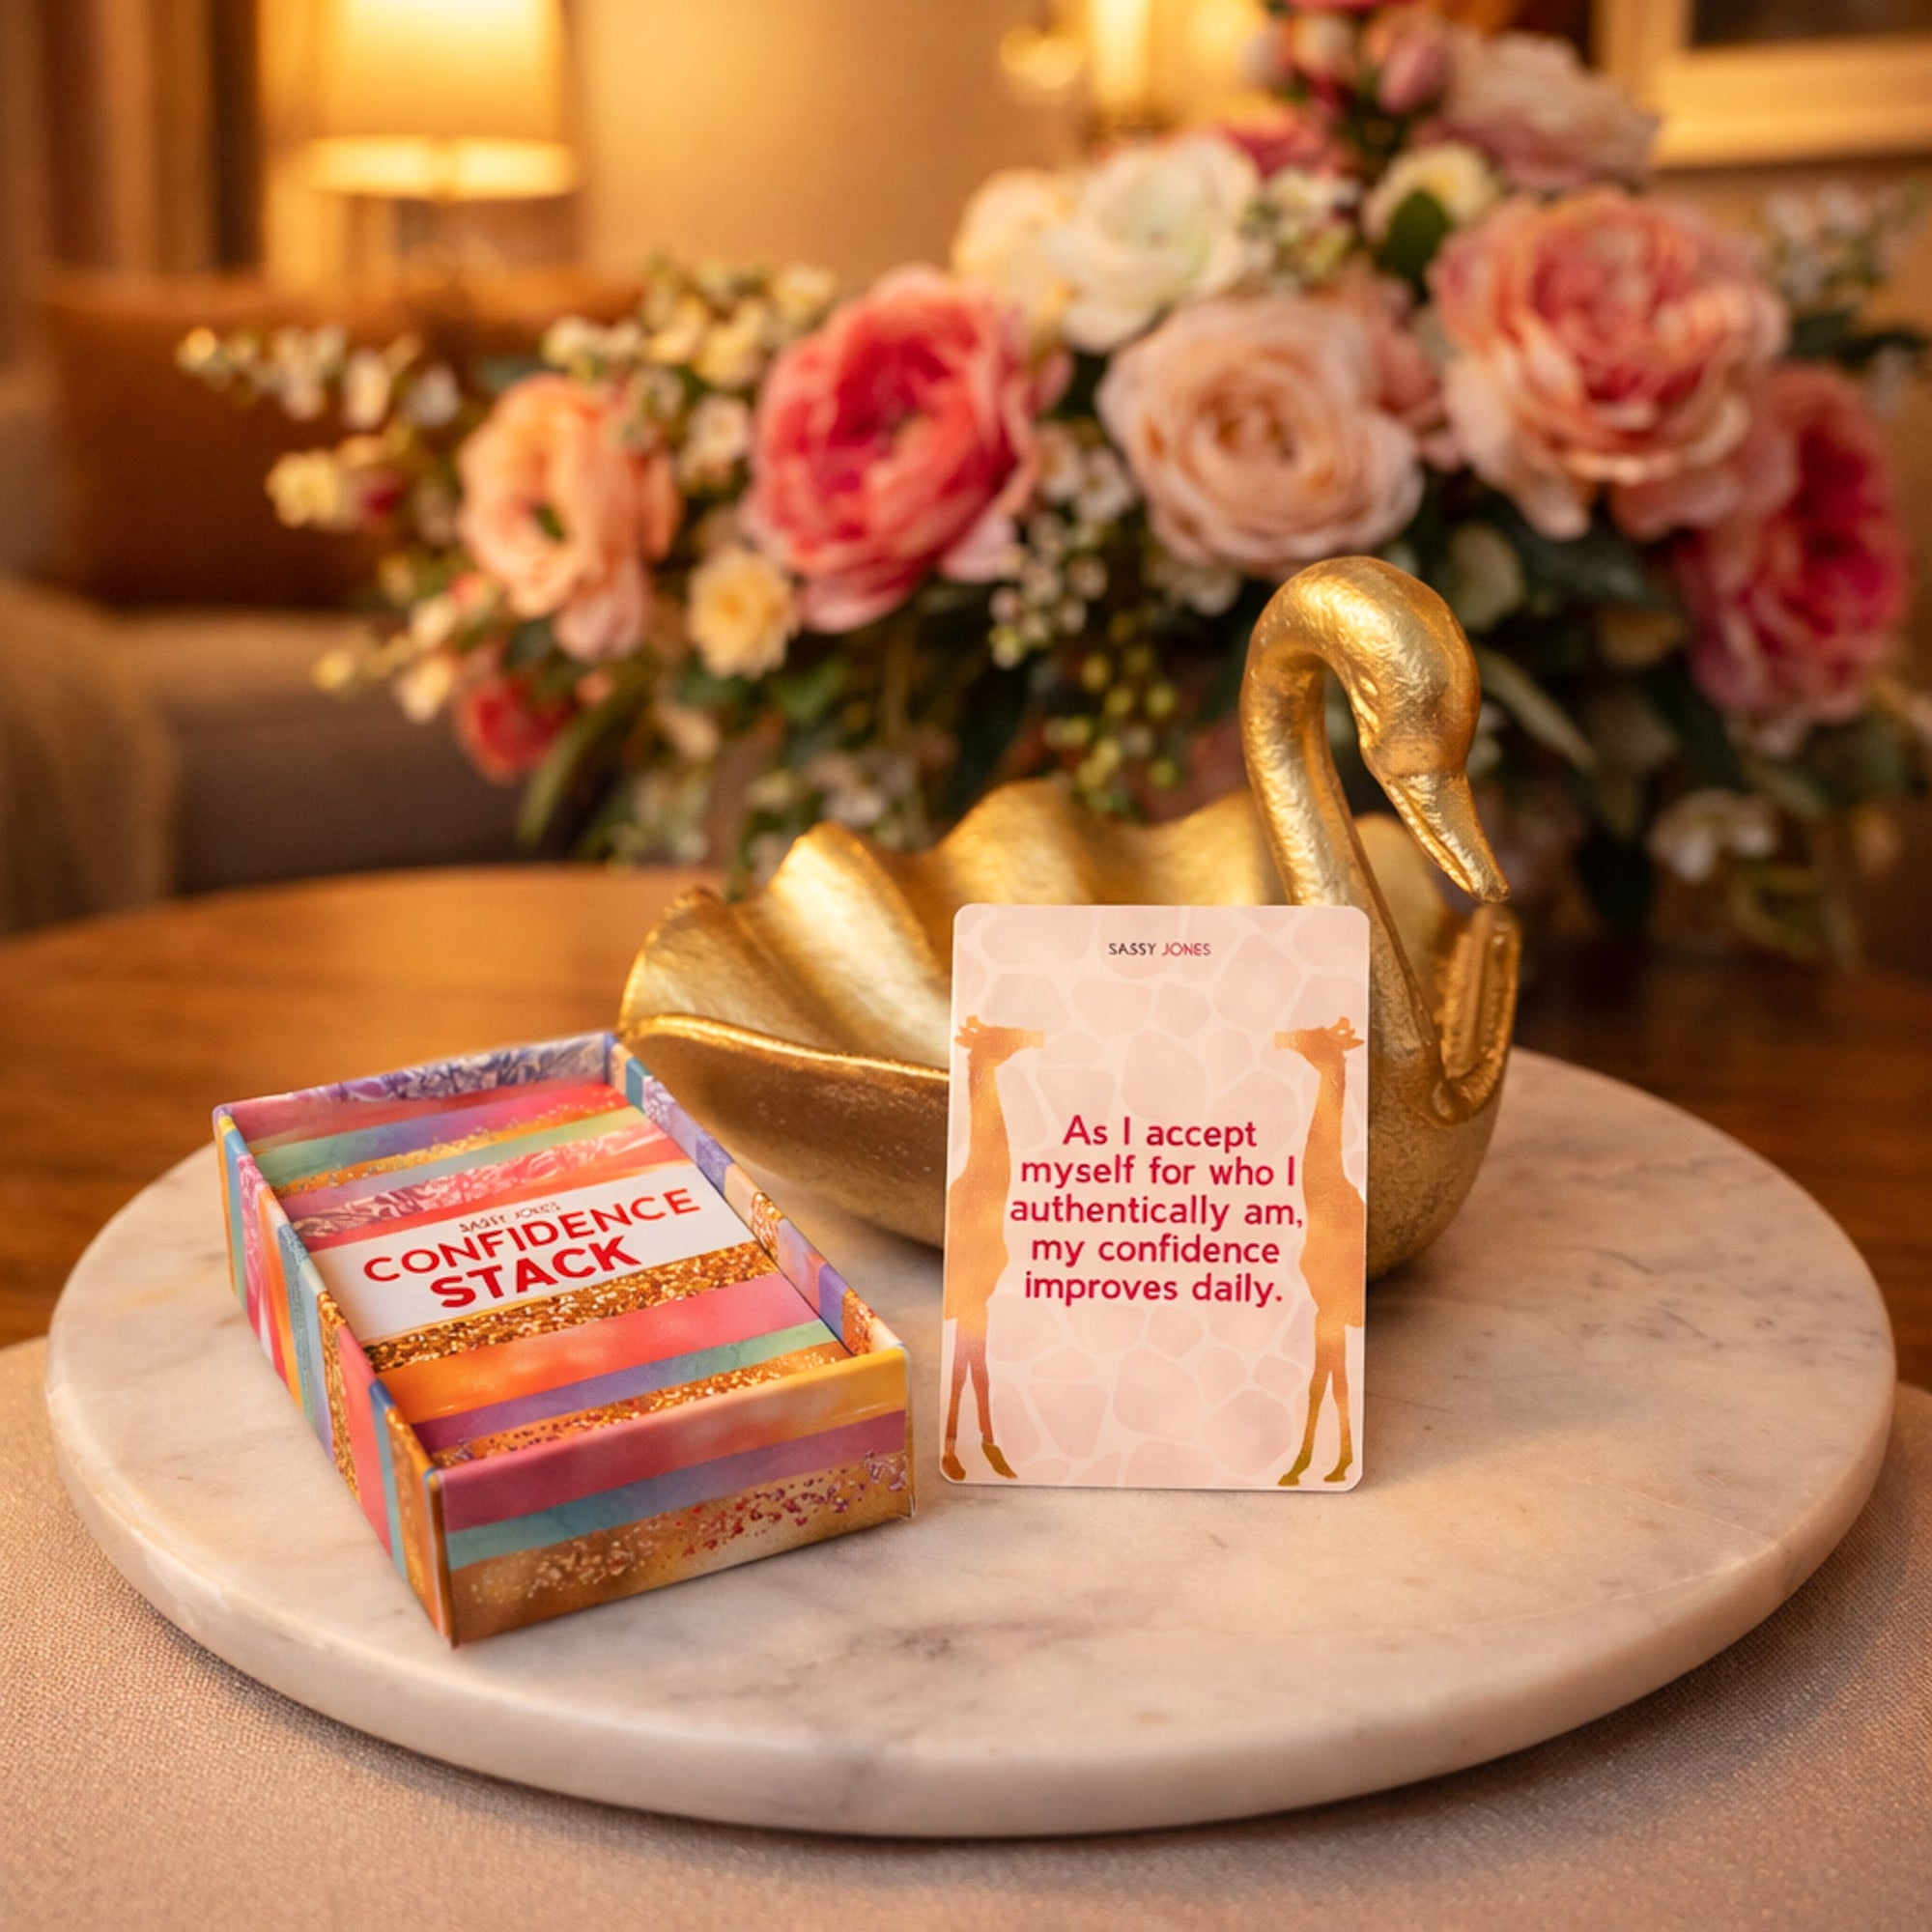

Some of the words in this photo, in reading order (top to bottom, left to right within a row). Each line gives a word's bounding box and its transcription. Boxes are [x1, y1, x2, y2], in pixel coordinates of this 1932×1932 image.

[1108, 942, 1157, 957] SASSY
[1161, 941, 1212, 957] JONES
[1062, 1114, 1109, 1147] As
[1123, 1116, 1131, 1147] I
[1146, 1121, 1259, 1153] accept
[1021, 1153, 1136, 1189] myself
[1149, 1154, 1196, 1186] for
[1208, 1155, 1275, 1187] who
[1287, 1155, 1295, 1187] I
[1009, 1194, 1231, 1233] authentically
[1243, 1203, 1303, 1229] am,
[363, 1187, 699, 1282] CONFIDENCE
[1032, 1238, 1086, 1268] my
[1097, 1232, 1280, 1265] confidence
[431, 1236, 641, 1309] STACK
[1025, 1270, 1179, 1308] improves
[1191, 1271, 1284, 1309] daily.
